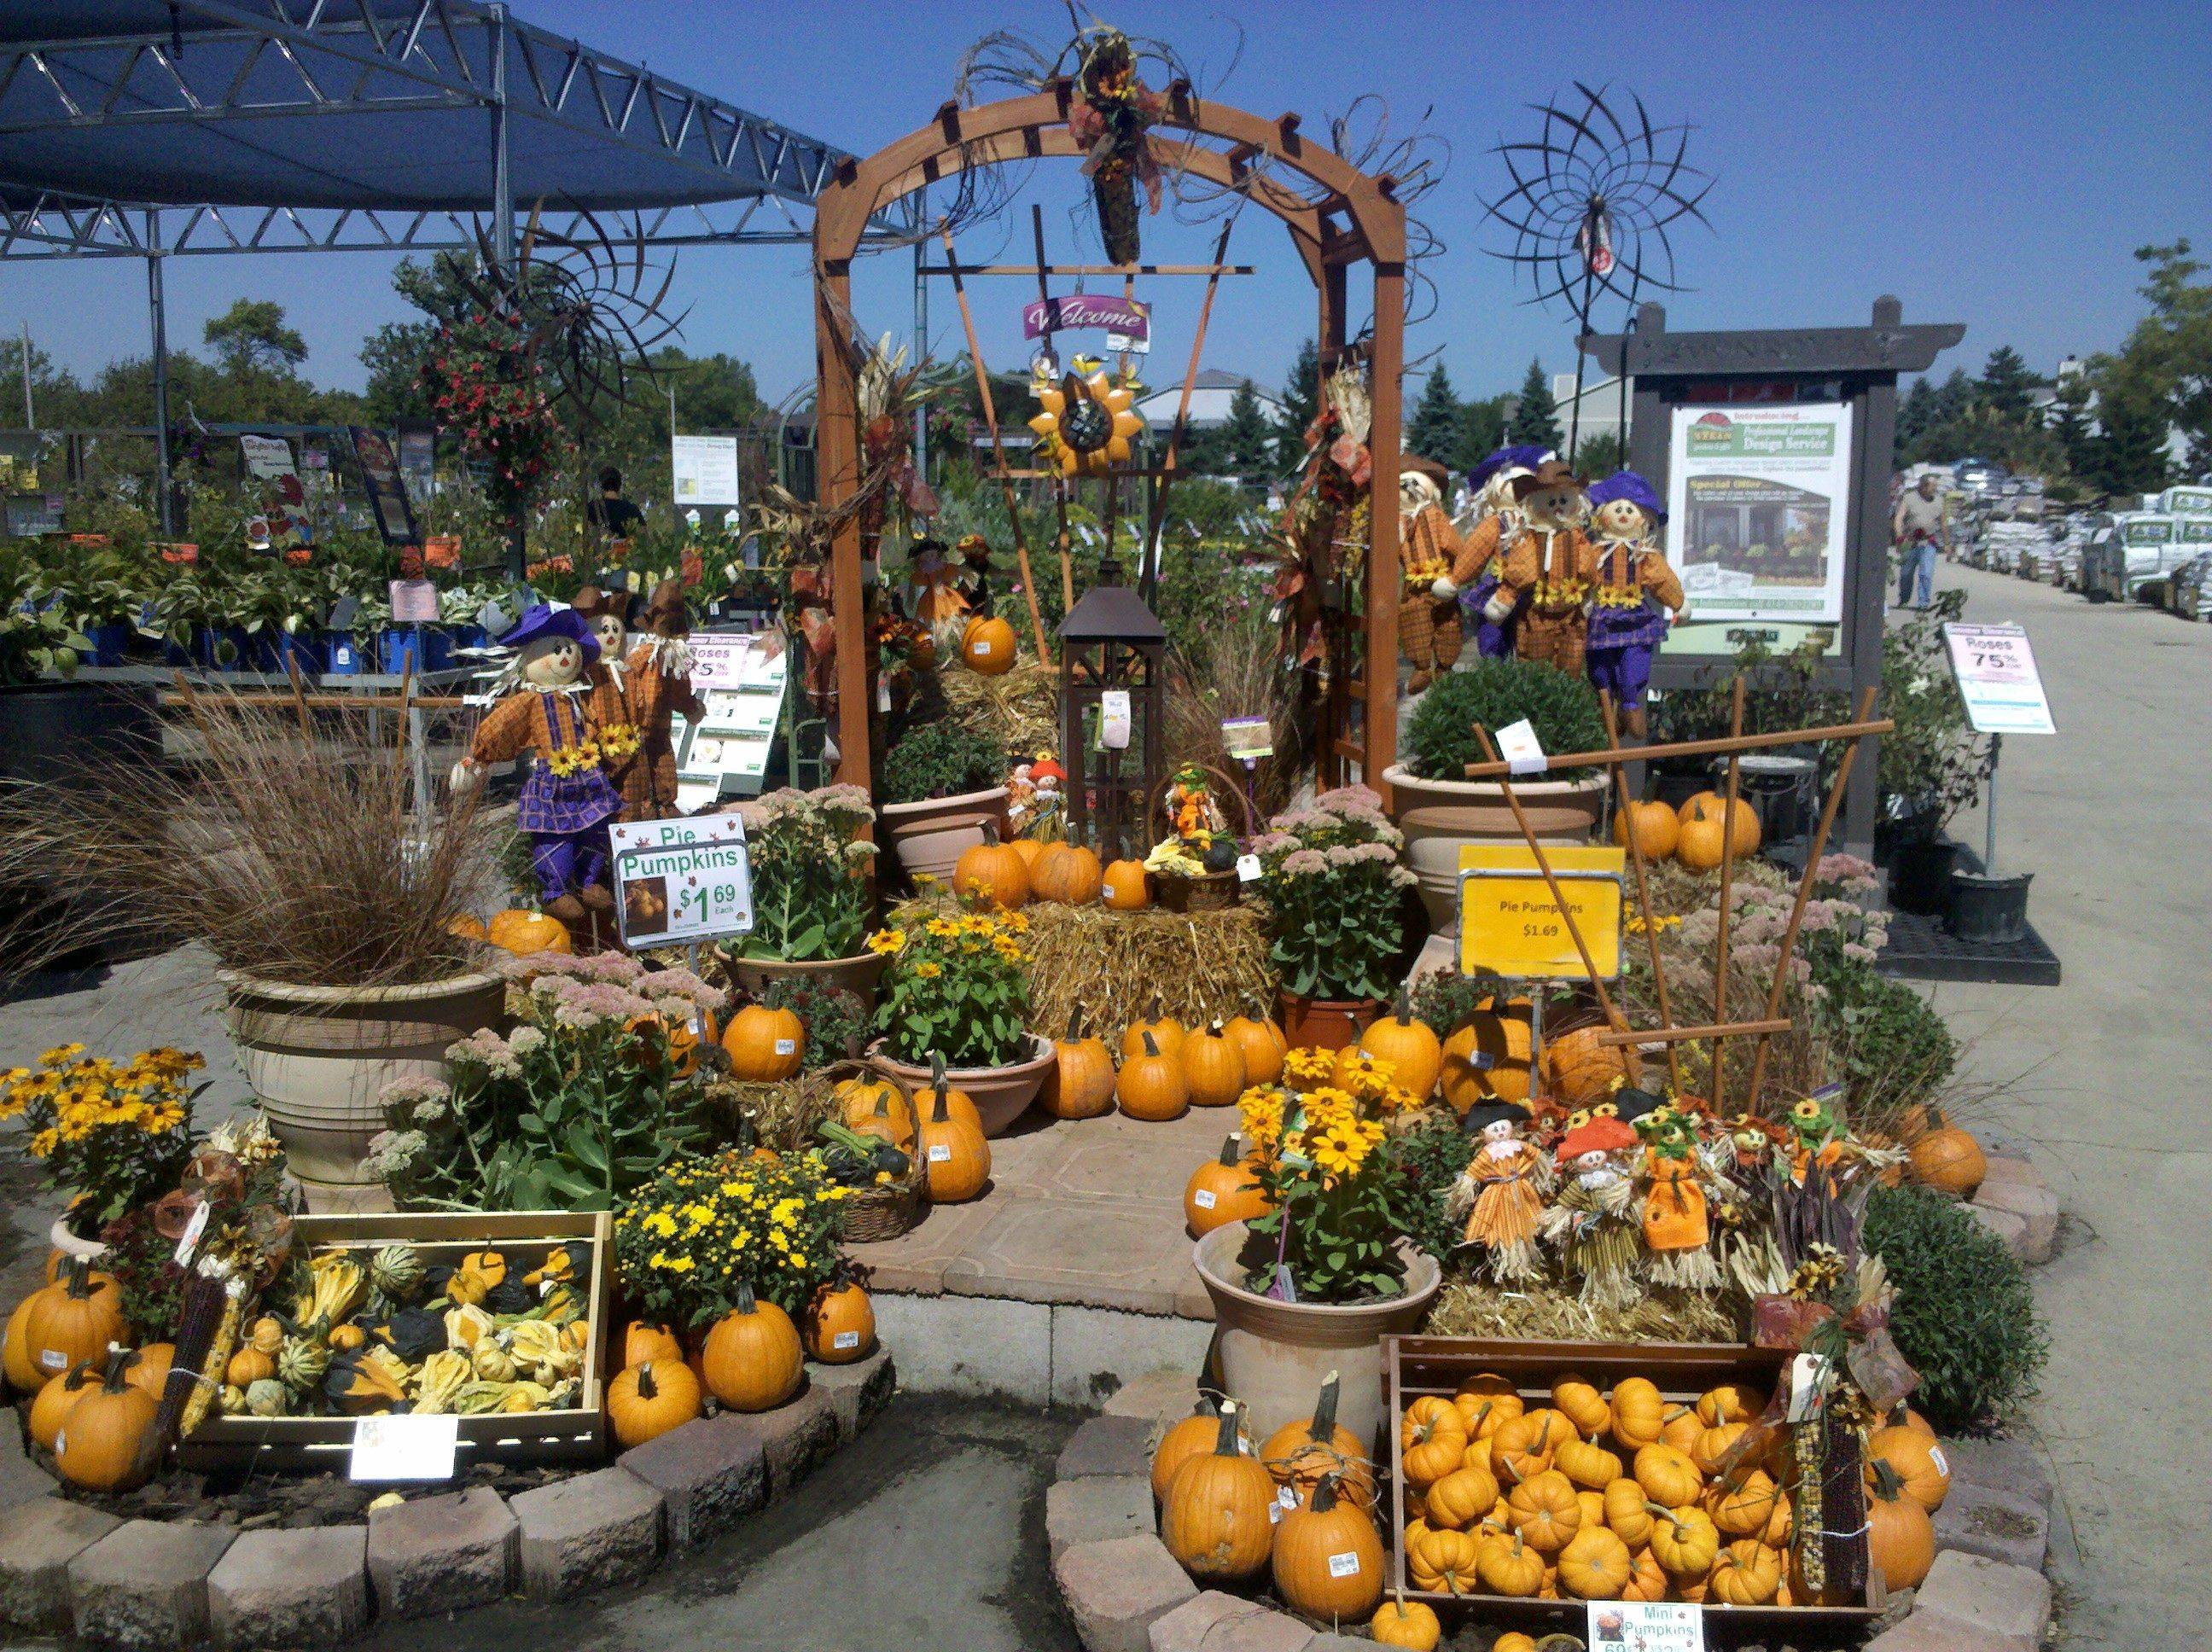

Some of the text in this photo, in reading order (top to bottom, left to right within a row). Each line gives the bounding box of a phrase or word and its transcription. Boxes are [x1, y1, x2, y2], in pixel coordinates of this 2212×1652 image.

[1028, 300, 1142, 331] Welcome
[1965, 637, 2014, 650] Roses
[660, 826, 696, 845] Pie
[624, 846, 739, 878] Pumpkins
[1499, 900, 1584, 916] Pie Pumpins
[1523, 923, 1558, 938] $1.69
[1644, 1606, 1674, 1620] Mini
[1624, 1621, 1695, 1637] Pumpkins
